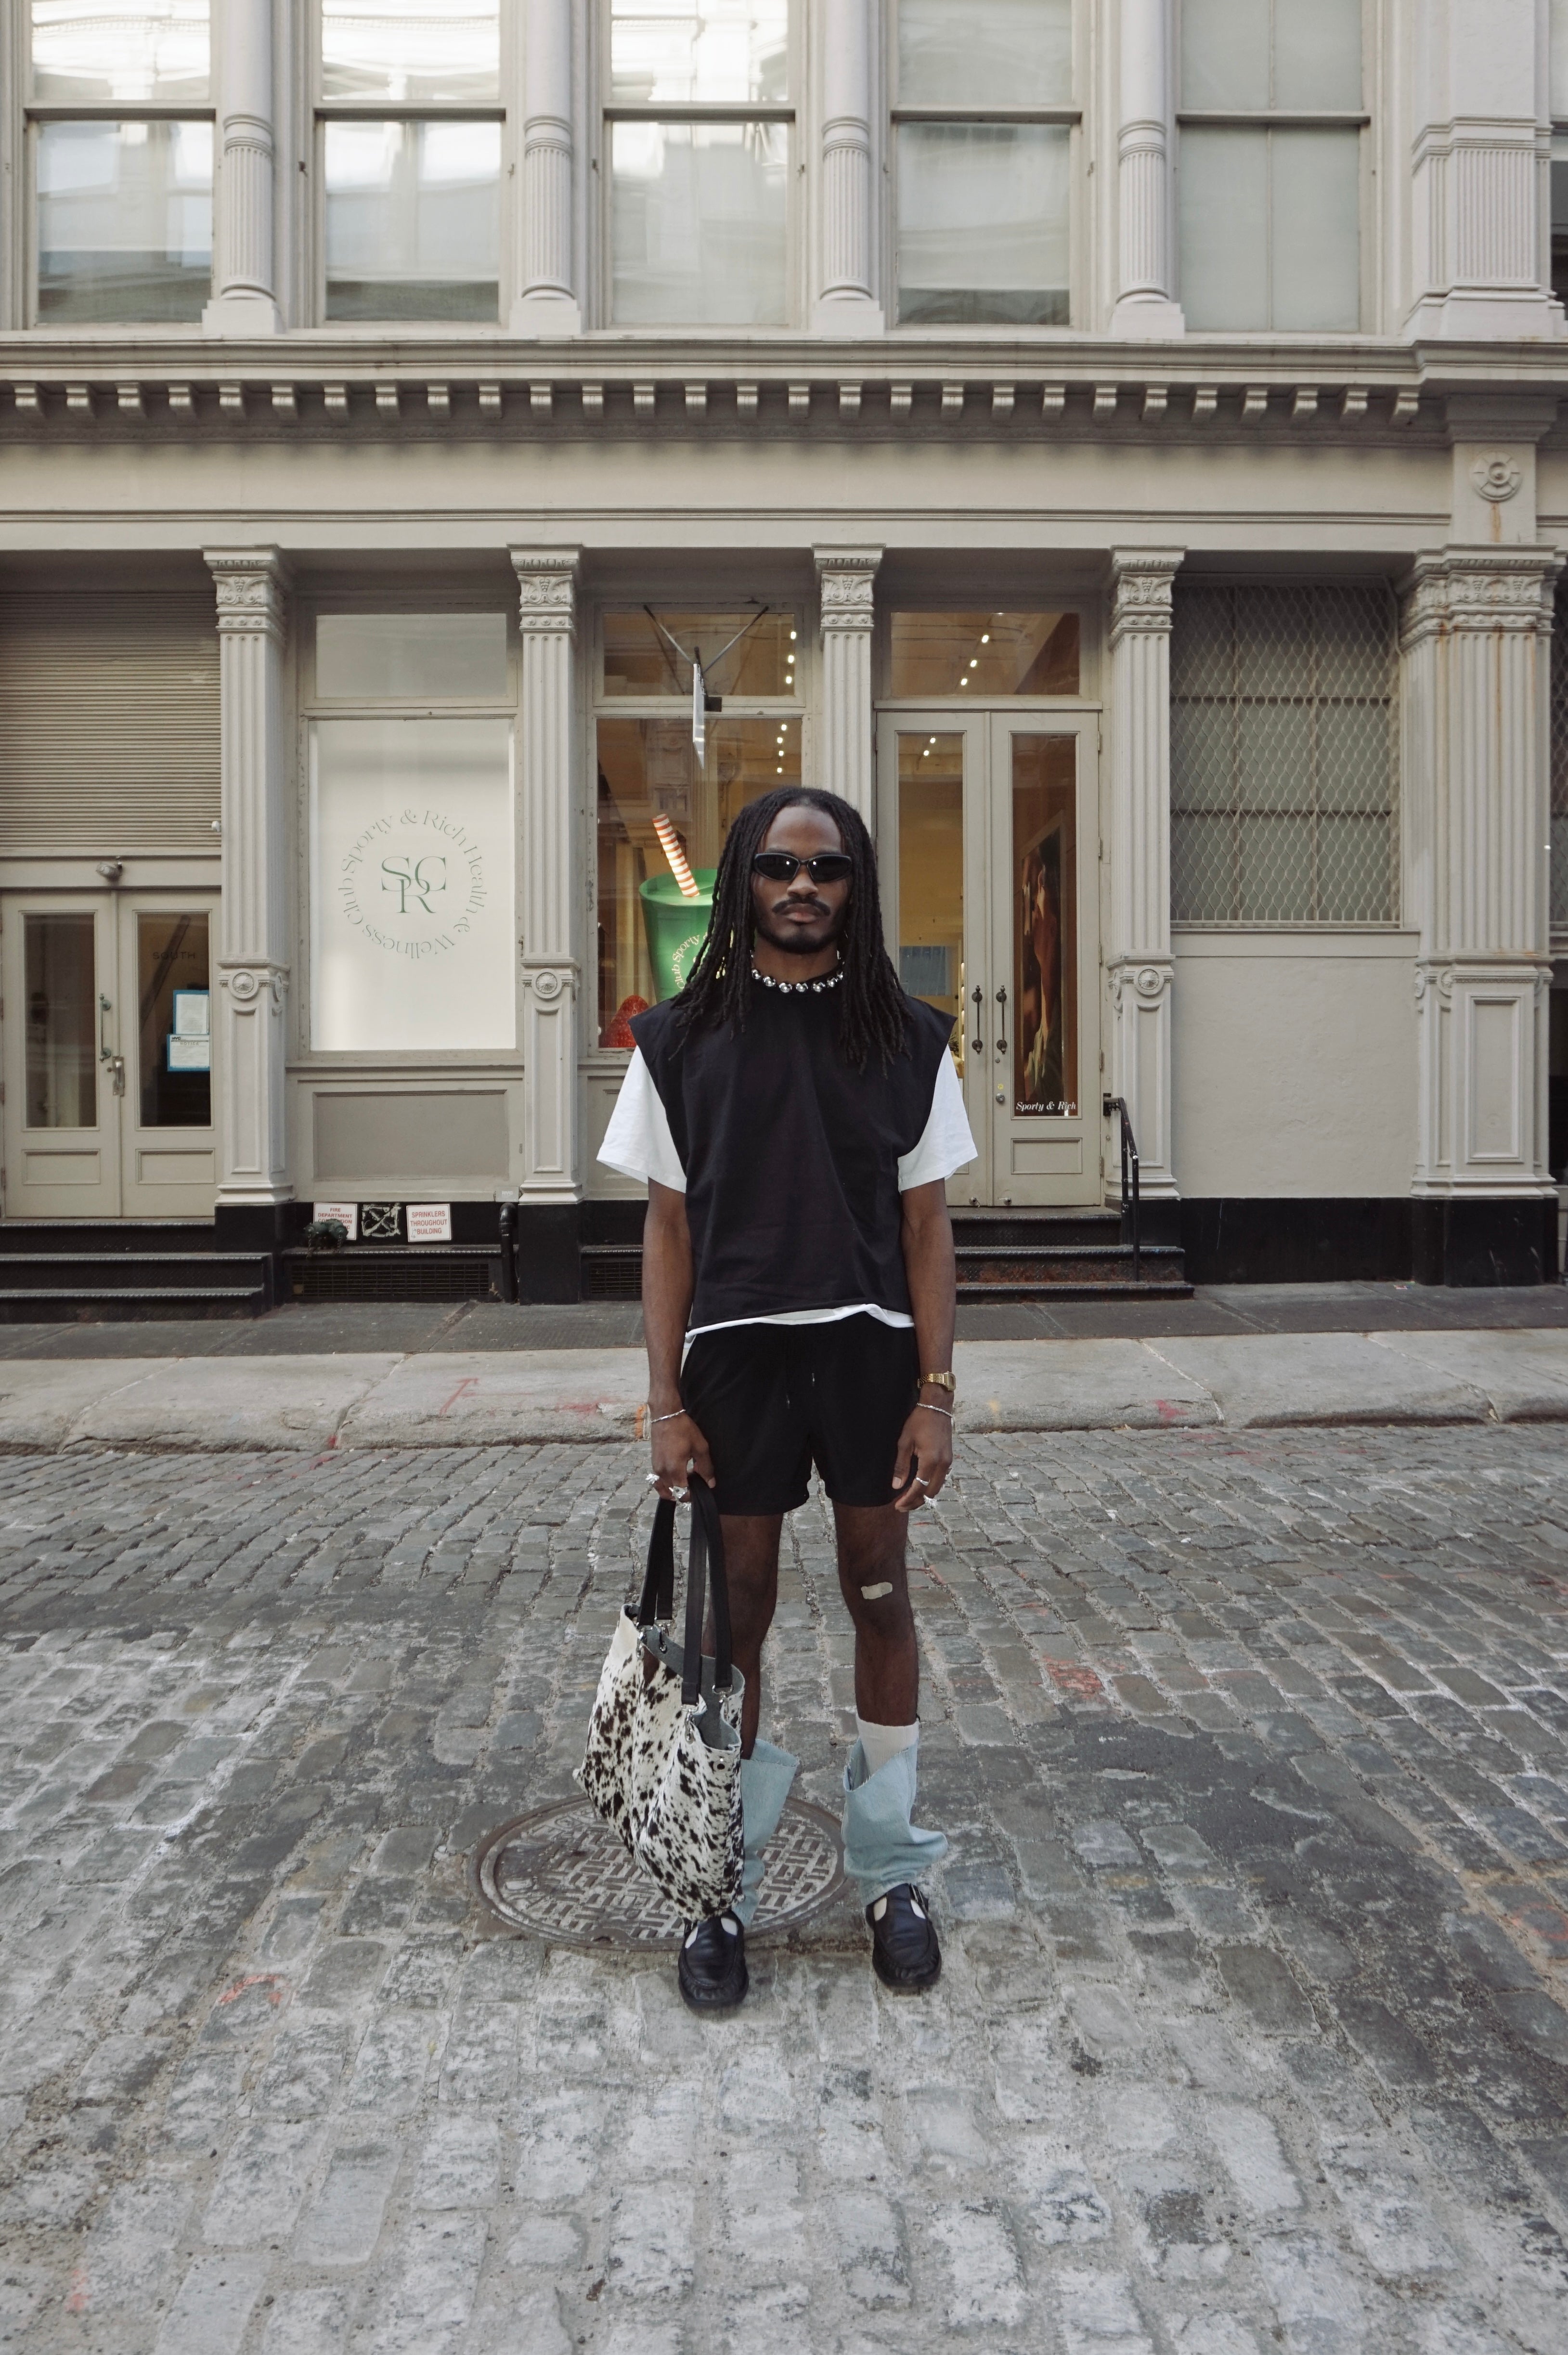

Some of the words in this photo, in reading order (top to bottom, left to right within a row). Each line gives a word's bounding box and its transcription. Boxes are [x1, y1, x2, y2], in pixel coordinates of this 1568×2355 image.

[401, 809, 417, 824] &
[422, 810, 466, 847] Rich
[341, 815, 392, 874] Sporty
[463, 844, 487, 914] Health
[338, 878, 363, 925] Club
[453, 917, 470, 932] &
[362, 924, 456, 959] Wellness
[672, 934, 700, 962] Sporty
[153, 951, 195, 959] SOUTH
[671, 964, 685, 989] Club
[1016, 1101, 1044, 1112] Sporty
[1046, 1101, 1055, 1110] &
[1058, 1101, 1076, 1110] Rich
[412, 1210, 445, 1218] SPRINKLERS
